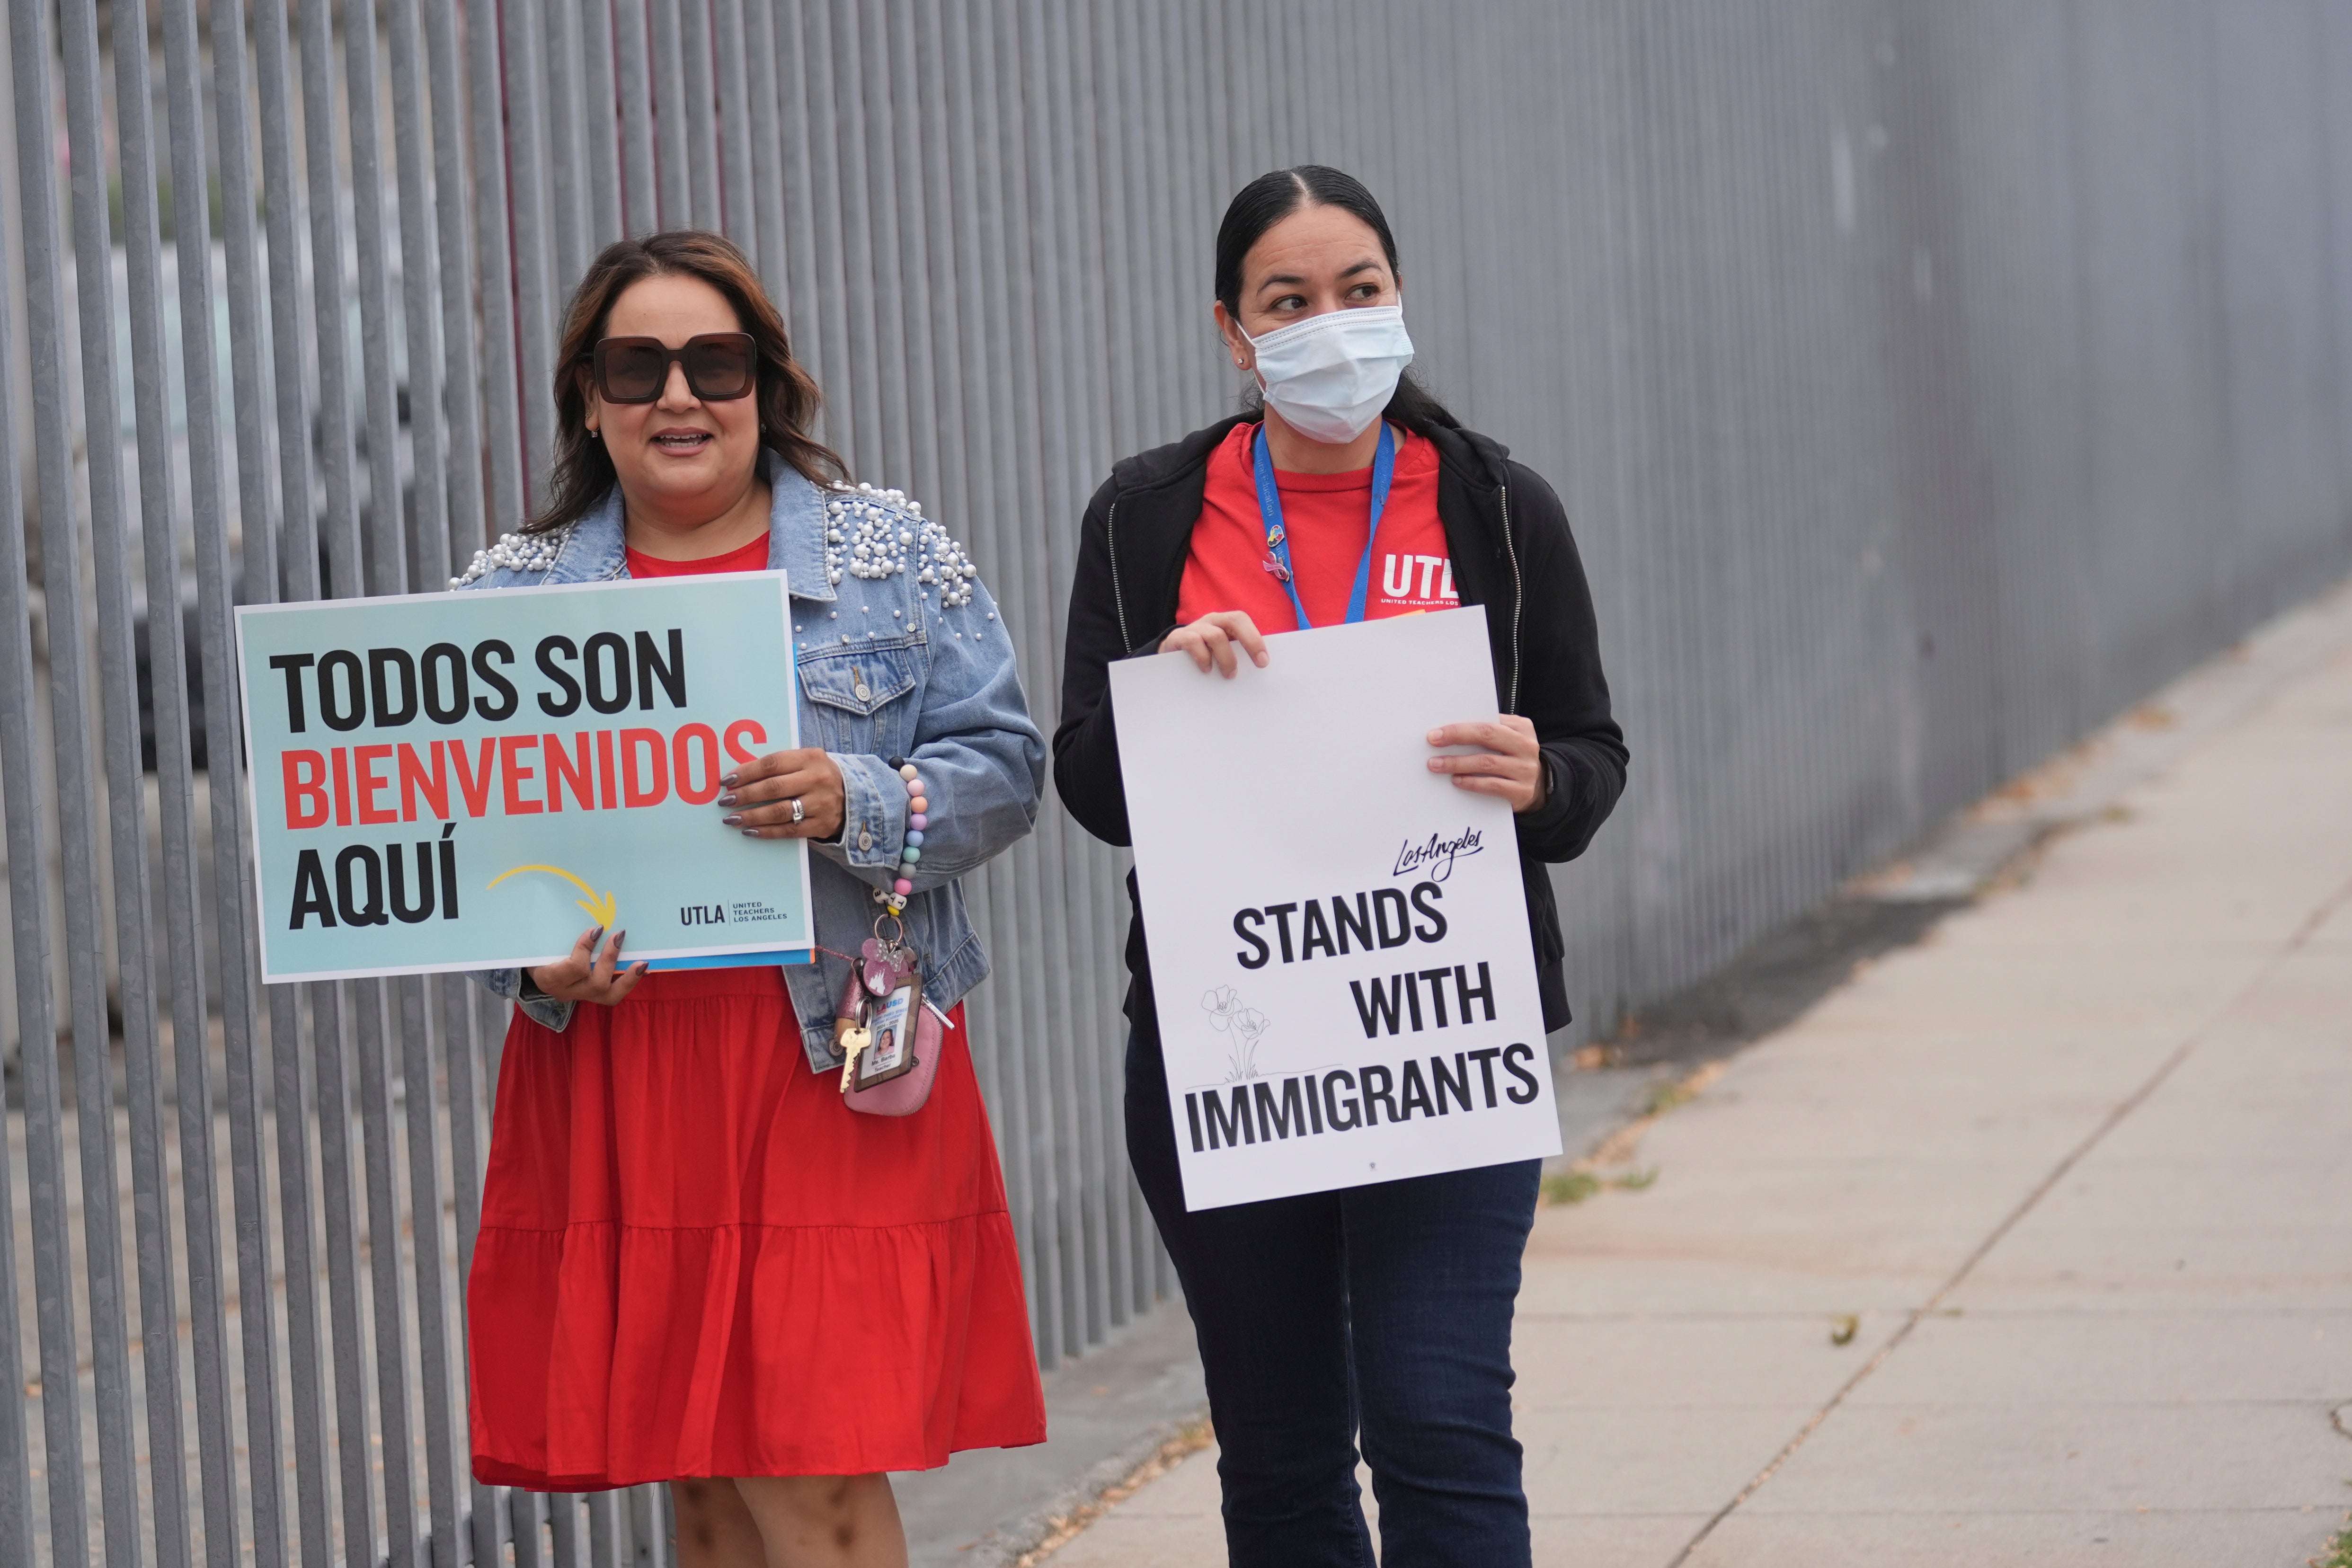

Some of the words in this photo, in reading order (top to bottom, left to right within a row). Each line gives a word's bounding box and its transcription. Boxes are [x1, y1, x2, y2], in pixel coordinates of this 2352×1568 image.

[269, 639, 519, 734] TODOS
[535, 629, 687, 718] SON
[282, 719, 767, 830] BIENVENIDOS
[289, 822, 459, 930] AQUÍ
[681, 904, 726, 926] UTLA
[752, 913, 788, 922] ANGELES
[1234, 882, 1447, 969] STANDS
[876, 998, 904, 1013] LAUSD
[1349, 961, 1496, 1038] WITH
[875, 1063, 891, 1072] Teacher
[1185, 1044, 1538, 1152] IMMIGRANTS
